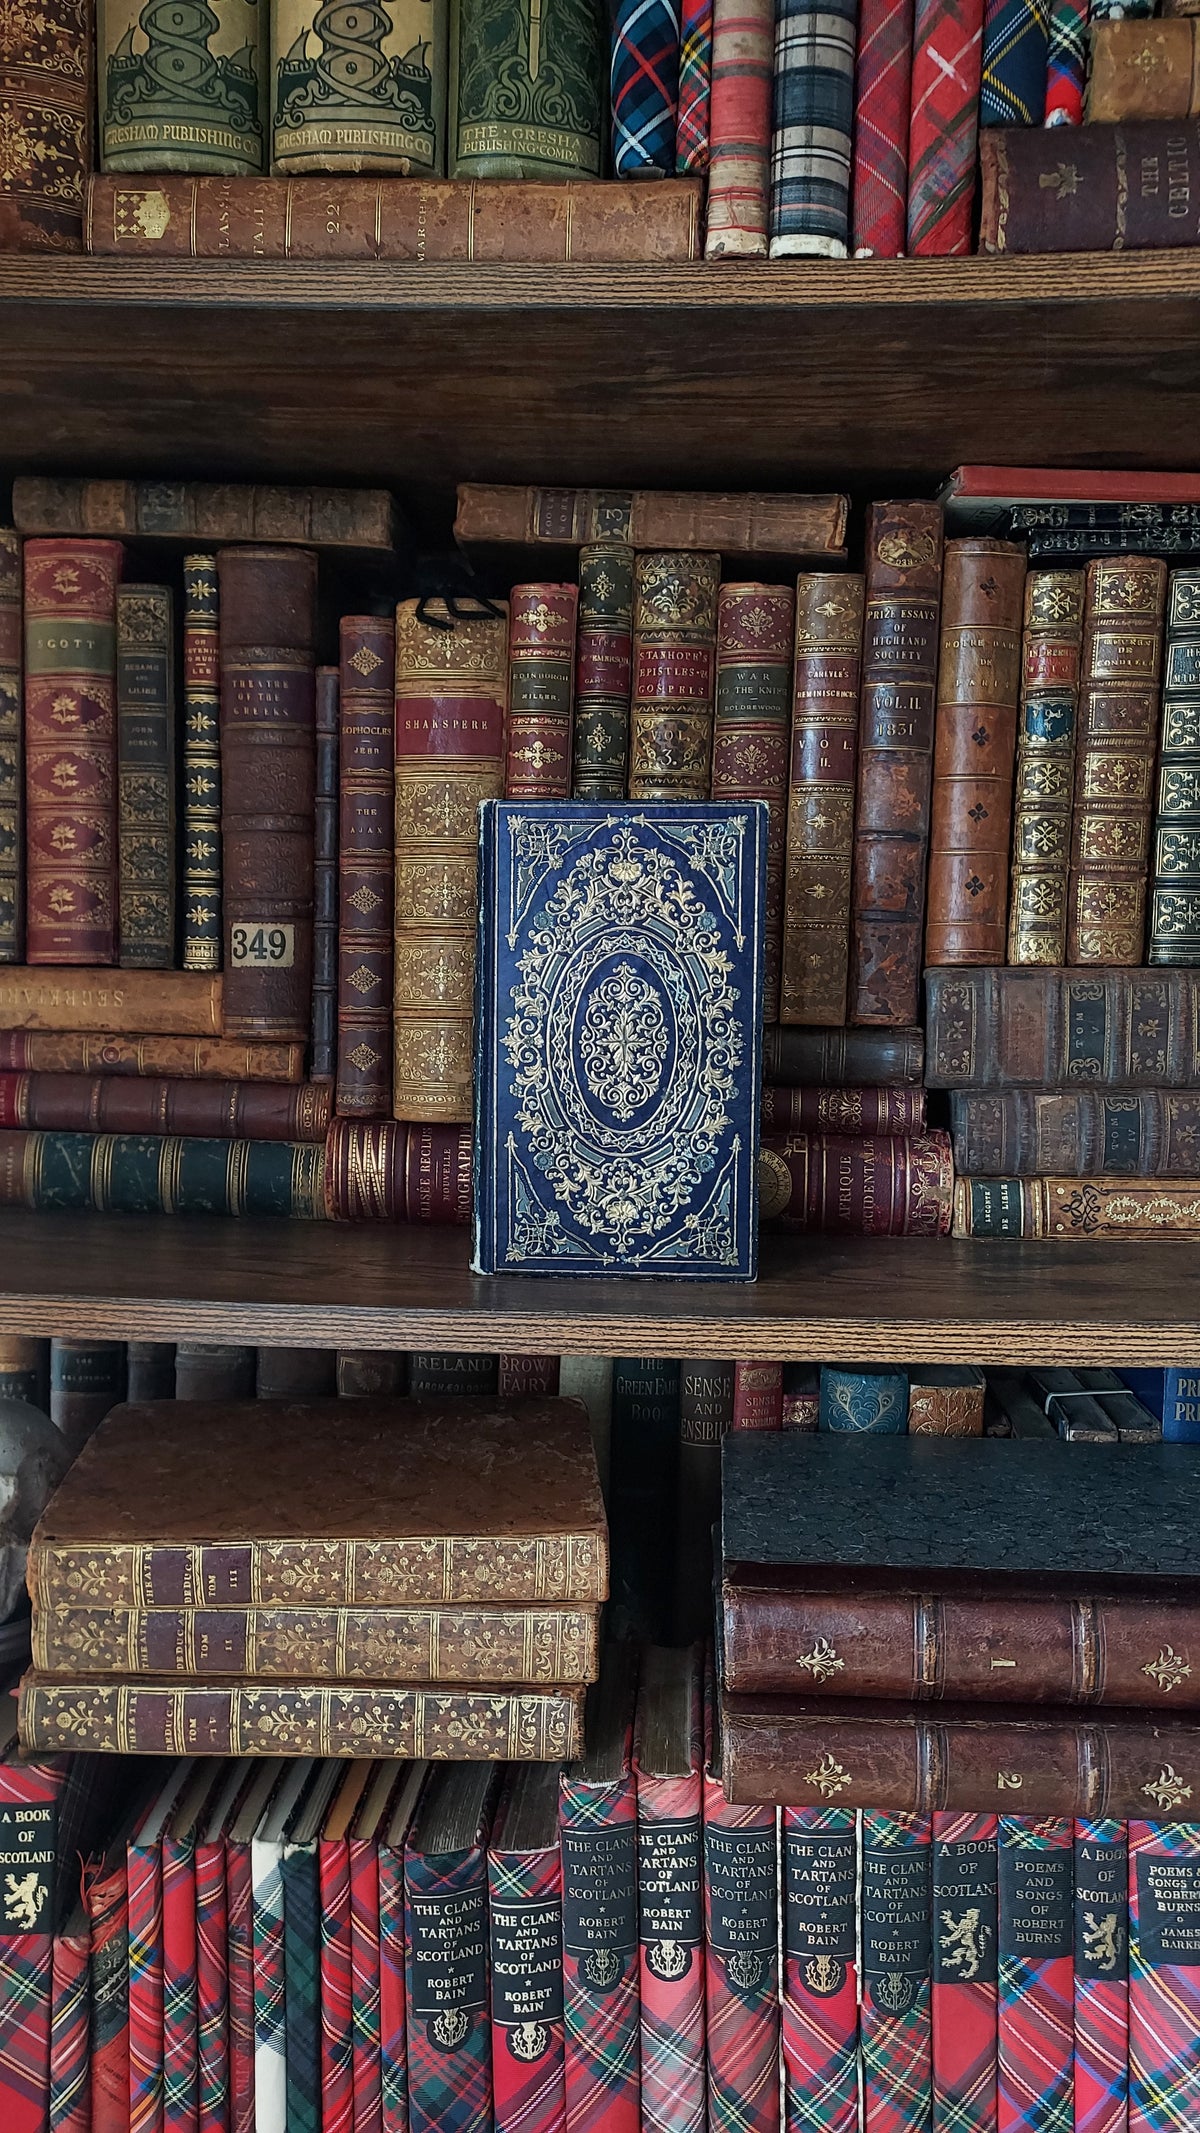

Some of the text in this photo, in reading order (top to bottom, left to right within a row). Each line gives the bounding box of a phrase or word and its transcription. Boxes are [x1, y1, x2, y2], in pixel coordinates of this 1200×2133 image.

[463, 125, 499, 140] THE
[106, 124, 259, 155] GRESHAM PUBLISHING CO
[276, 129, 432, 156] GRESHAM PUBLISHING CO
[1141, 157, 1159, 197] THE
[1167, 138, 1190, 217] CELTIC
[606, 508, 624, 522] 3
[867, 609, 935, 620] PRIZE ESSAYS
[893, 623, 907, 632] OF
[872, 636, 927, 646] HIGHLAND
[945, 640, 984, 648] NOTRE
[873, 650, 922, 660] SOCIETY
[512, 672, 569, 681] EDINBURGH
[737, 673, 770, 681] WAR
[808, 667, 849, 678] CARLYLE'S
[232, 679, 289, 689] THEATRE
[638, 684, 704, 696] GOSPELS
[238, 692, 280, 701] OF THE
[735, 686, 753, 695] THE
[233, 707, 289, 717] GREEKS
[724, 704, 781, 712] BOLDREWOOD
[405, 719, 489, 730] SHAKSPERE
[877, 723, 914, 737] 1831
[342, 726, 392, 736] SOPHOCLES
[651, 730, 691, 742] VOL.
[356, 808, 377, 816] THE
[350, 826, 383, 834] AJAX
[232, 929, 287, 961] 349
[1075, 1011, 1084, 1049] TOM
[1111, 1117, 1120, 1150] TOM
[420, 1127, 433, 1172] RECLUS
[443, 1148, 451, 1201] NOUVELLE
[838, 1156, 853, 1220] AFRIQUE
[1001, 1183, 1009, 1231] DE LISLE
[412, 1355, 493, 1371] IRELAND
[500, 1354, 555, 1372] BROWN
[639, 1357, 664, 1370] THE
[503, 1373, 549, 1391] FAIRY
[616, 1376, 653, 1395] GREEN
[684, 1375, 731, 1399] SENSE
[746, 1397, 775, 1407] SENSE
[694, 1403, 722, 1416] AND
[229, 1570, 237, 1588] III
[208, 1575, 216, 1597] TOM
[200, 1634, 209, 1658] TOM
[225, 1639, 232, 1651] II
[990, 1656, 1016, 1670] 1
[189, 1717, 197, 1743] TOM
[997, 1771, 1024, 1789] 2
[1, 1809, 51, 1823] A BOOK
[18, 1830, 35, 1842] OF
[657, 1831, 699, 1846] CLANS
[566, 1836, 635, 1852] THE CLANS
[708, 1836, 732, 1854] THE
[788, 1843, 814, 1857] THE
[938, 1839, 997, 1857] A BOOK
[0, 1850, 55, 1864] SCOTLAND
[652, 1847, 676, 1855] AND
[1080, 1847, 1091, 1860] A
[591, 1854, 613, 1862] AND
[731, 1856, 755, 1864] AND
[811, 1860, 836, 1868] AND
[570, 1861, 632, 1877] TARTANS
[712, 1862, 774, 1877] TARTANS
[959, 1862, 978, 1875] OF
[1014, 1861, 1064, 1873] POEMS
[1149, 1865, 1193, 1877] POEMS
[658, 1870, 673, 1879] OF
[1098, 1870, 1115, 1882] OF
[594, 1878, 608, 1887] OF
[736, 1880, 750, 1888] OF
[884, 1877, 908, 1886] AND
[1025, 1877, 1054, 1887] AND
[1147, 1877, 1187, 1888] SONGS
[568, 1885, 634, 1900] SCOTLAND
[711, 1885, 775, 1902] SCOTLAND
[816, 1884, 831, 1893] OF
[865, 1885, 927, 1899] TARTANS
[1015, 1890, 1063, 1901] SONGS
[413, 1896, 484, 1916] THE CLANS
[888, 1902, 903, 1910] OF
[1030, 1905, 1048, 1915] OF
[492, 1910, 561, 1927] THE CLANS
[642, 1907, 691, 1919] ROBERT
[439, 1916, 462, 1925] AND
[579, 1916, 625, 1927] ROBERT
[651, 1920, 683, 1931] BAIN
[721, 1916, 768, 1929] ROBERT
[1012, 1918, 1065, 1929] ROBERT
[419, 1920, 481, 1938] TARTANS
[516, 1928, 538, 1936] AND
[799, 1922, 848, 1933] ROBERT
[587, 1929, 618, 1939] BAIN
[729, 1931, 760, 1940] BAIN
[807, 1935, 839, 1945] BAIN
[1015, 1932, 1062, 1944] BURNS
[443, 1940, 458, 1949] OF
[496, 1935, 558, 1950] TARTANS
[870, 1939, 919, 1951] ROBERT
[416, 1943, 484, 1962] SCOTLAND
[520, 1951, 535, 1961] OF
[879, 1952, 911, 1962] BAIN
[494, 1958, 562, 1975] SCOTLAND
[427, 1973, 474, 1988] ROBERT
[435, 1987, 467, 2000] BAIN
[504, 1987, 553, 2001] ROBERT
[513, 2001, 544, 2013] BAIN
